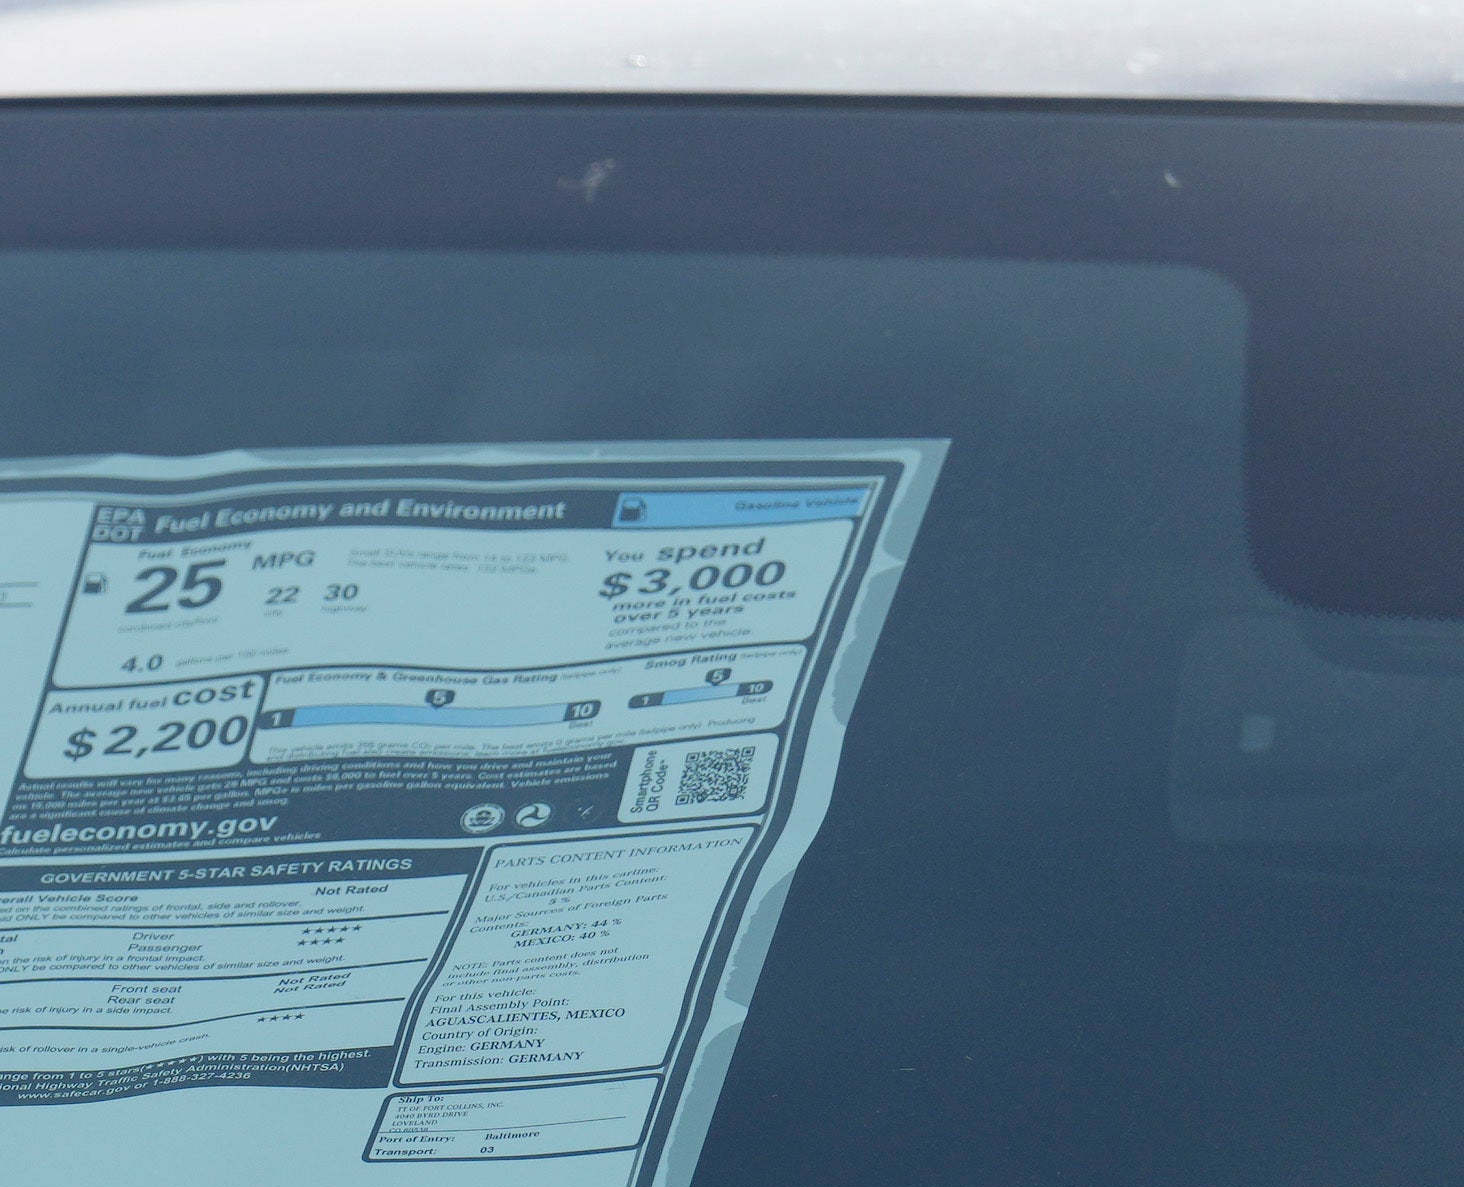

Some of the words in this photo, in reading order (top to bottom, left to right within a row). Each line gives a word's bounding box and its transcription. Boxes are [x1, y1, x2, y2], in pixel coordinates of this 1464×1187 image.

[96, 507, 147, 525] EPA
[155, 511, 210, 534] Fuel
[215, 502, 333, 528] Economy
[338, 499, 390, 517] and
[396, 498, 566, 521] Environment
[92, 525, 145, 542] DOT
[138, 549, 173, 560] Fuel
[181, 541, 252, 558] Economy
[605, 548, 644, 563] You
[657, 537, 765, 563] spend
[125, 560, 226, 614] 25
[252, 549, 315, 570] MPG
[264, 585, 301, 606] 22
[323, 583, 360, 601] 30
[613, 599, 667, 612] more
[673, 596, 690, 606] in
[698, 592, 736, 605] fuel
[743, 590, 797, 602] costs
[613, 611, 663, 624] over
[668, 609, 680, 620] 5
[688, 604, 745, 620] years
[121, 653, 164, 672] 4.0
[643, 660, 687, 671] Smog
[691, 651, 738, 666] Rating
[712, 670, 724, 682] 5
[48, 700, 123, 714] Annual
[129, 696, 168, 711] fuel
[173, 680, 254, 706] cost
[747, 682, 765, 694] 10
[571, 702, 594, 718] 10
[630, 749, 658, 814] Smartphone
[646, 789, 660, 812] QR
[0, 816, 279, 845] fueleconomy.gov
[494, 855, 546, 869] PARTS
[549, 850, 628, 865] CONTENT
[627, 838, 746, 858] INFORMATION
[40, 869, 176, 884] GOVERNMENT
[178, 865, 246, 880] 5-STAR
[250, 861, 324, 878] SAFETY
[328, 857, 413, 873] RATINGS
[314, 886, 341, 897] Not
[345, 883, 390, 895] Rated
[578, 883, 612, 894] Parts
[614, 874, 669, 888] Content:
[38, 893, 91, 903] Vehicle
[95, 893, 140, 903] Score
[474, 914, 512, 925] Major
[514, 907, 566, 920] Sources
[568, 902, 581, 912] of
[582, 896, 632, 911] Foreign
[634, 891, 670, 903] Parts
[469, 921, 530, 934] Contents:
[510, 921, 590, 939] GERMANY:
[591, 919, 610, 929] 44
[612, 917, 623, 926] %
[132, 932, 176, 942] Driver
[512, 934, 577, 949] MEXICO:
[579, 930, 597, 941] 40
[600, 929, 611, 938] %
[127, 943, 204, 955] Passenger
[278, 976, 305, 987] Not
[307, 972, 352, 983] Rated
[111, 984, 150, 994] Front
[152, 984, 183, 994] seat
[434, 994, 458, 1004] For
[459, 991, 485, 1001] this
[487, 986, 538, 999] vehicle:
[107, 995, 142, 1005] Rear
[145, 995, 176, 1005] seat
[430, 1005, 462, 1016] Final
[464, 1000, 530, 1013] Assembly
[531, 997, 570, 1009] Point:
[424, 1010, 562, 1028] AGUASCALIENTES,
[565, 1007, 626, 1020] MEXICO
[422, 1028, 475, 1042] Country
[477, 1026, 492, 1038] of
[493, 1025, 539, 1040] Origin:
[207, 1053, 236, 1062] with
[239, 1053, 249, 1062] 5
[251, 1053, 290, 1063] being
[292, 1052, 316, 1062] the
[318, 1049, 372, 1062] highest.
[417, 1043, 466, 1056] Engine:
[469, 1038, 547, 1052] GERMANY
[413, 1055, 504, 1070] Transmission:
[508, 1050, 585, 1064] GERMANY
[32, 1071, 64, 1081] from
[68, 1071, 76, 1081] 1
[78, 1071, 93, 1080] to
[95, 1070, 106, 1080] 5
[35, 1081, 94, 1093] Highway
[97, 1074, 141, 1087] Traffic
[142, 1066, 184, 1082] Safety
[186, 1061, 346, 1074] Administration(NHTSA)
[17, 1084, 131, 1100] www.safecar.gov
[133, 1082, 150, 1091] or
[151, 1072, 252, 1087] 1-888-327-4236
[397, 1105, 409, 1113] TT
[423, 1104, 447, 1112] FORT
[446, 1102, 486, 1112] COLLINS,
[398, 1095, 425, 1105] Ship
[426, 1094, 446, 1104] To:
[391, 1119, 439, 1127] LOVELAND
[394, 1112, 417, 1120] 4040
[416, 1111, 443, 1120] BYRD
[441, 1110, 470, 1119] DRIVE
[378, 1135, 405, 1144] Port
[406, 1134, 420, 1143] of
[419, 1134, 457, 1145] Entry:
[485, 1129, 540, 1141] Baltimore
[374, 1148, 438, 1157] Transport:
[479, 1145, 495, 1154] 03
